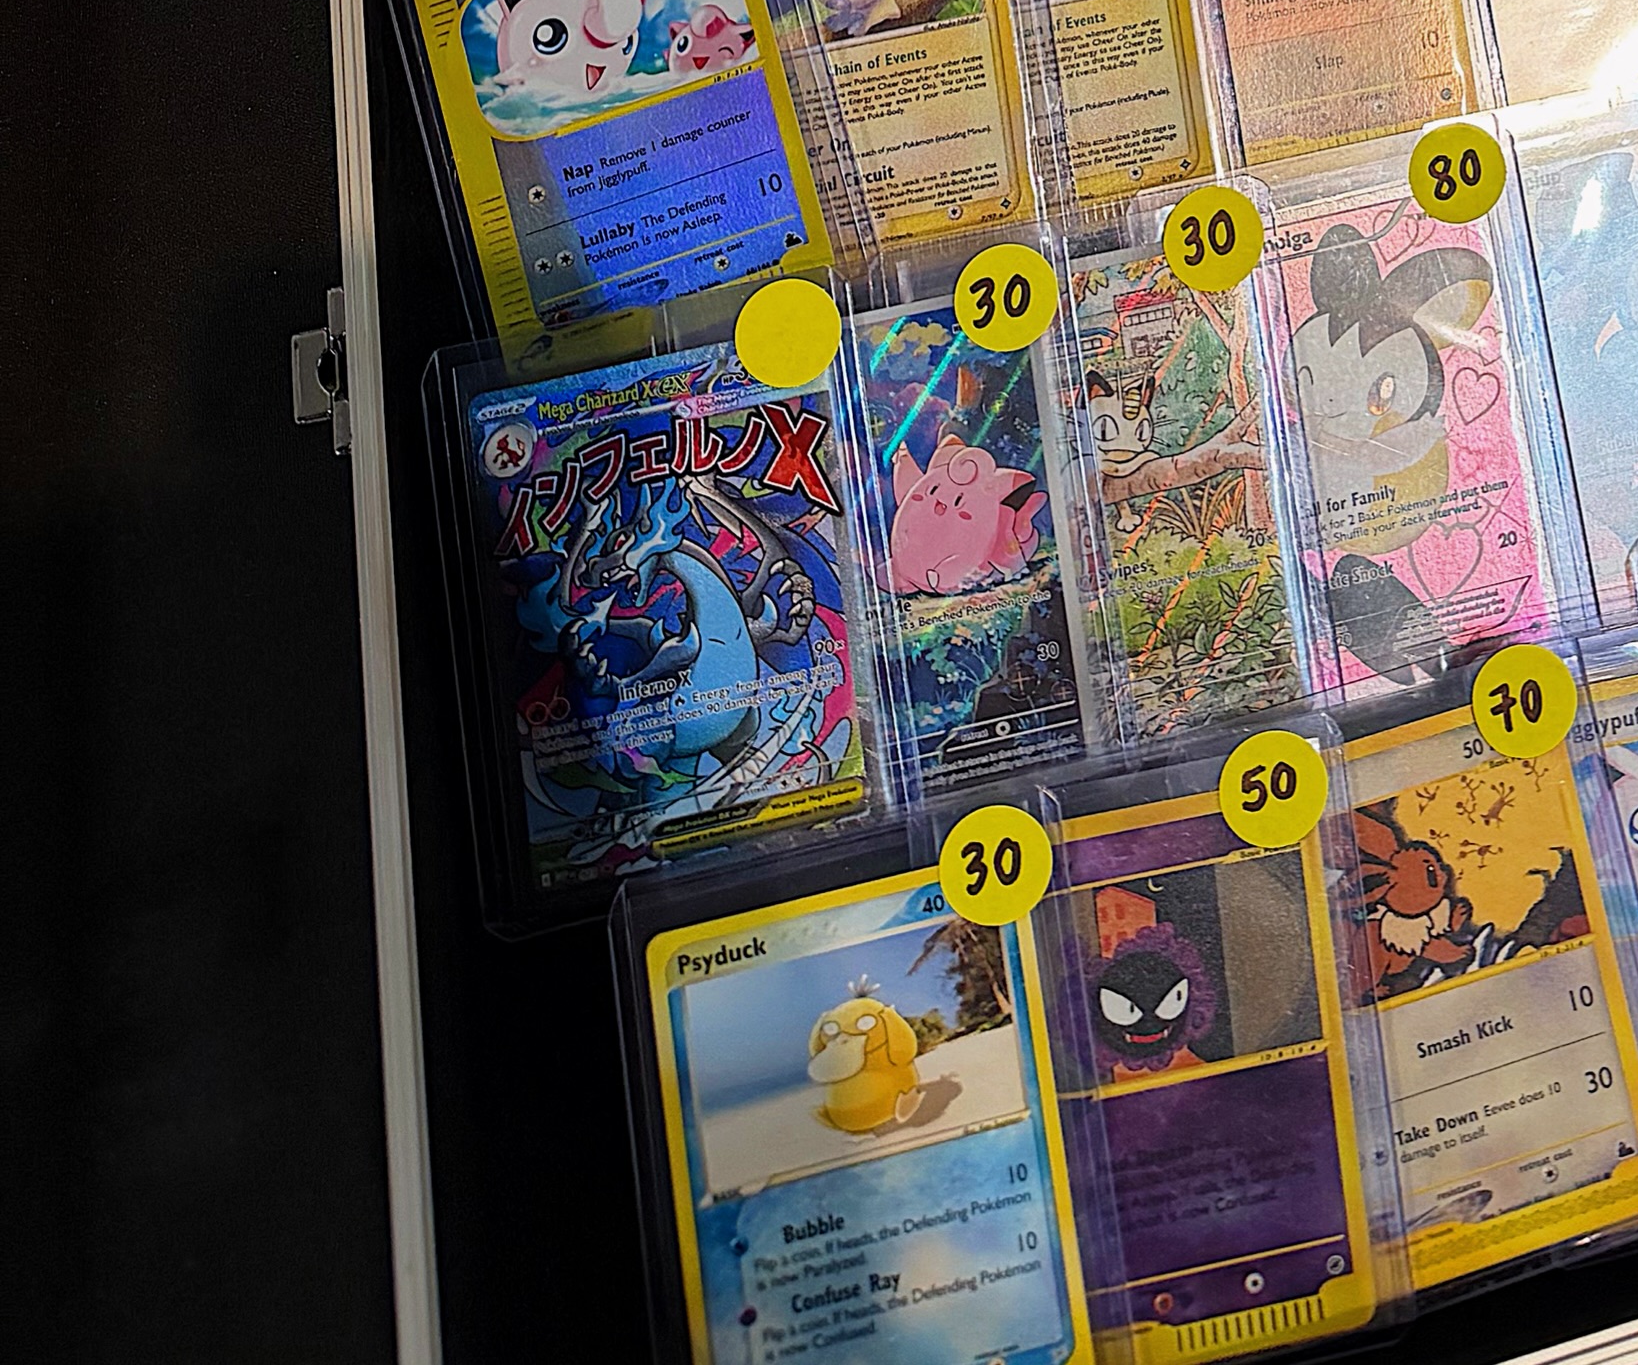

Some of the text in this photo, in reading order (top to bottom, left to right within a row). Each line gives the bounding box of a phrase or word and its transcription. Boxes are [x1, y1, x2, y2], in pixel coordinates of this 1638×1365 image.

[563, 149, 647, 182] Nap Remove
[1428, 150, 1481, 200] 80
[757, 173, 783, 197] 10
[579, 191, 727, 250] Lullaby The Defending
[1181, 209, 1235, 266] 30
[969, 276, 1030, 327] 30
[1324, 484, 1396, 513] for Family
[1489, 681, 1543, 732] 70
[1241, 762, 1297, 812] 50
[961, 837, 1021, 896] 30
[677, 938, 767, 975] Psyduck
[1568, 985, 1593, 1011] 10
[1417, 1014, 1514, 1059] Smash Kick
[1585, 1066, 1613, 1093] 30
[1395, 1107, 1479, 1145] Take Down
[1008, 1164, 1028, 1183] 10
[784, 1212, 845, 1244] Bubble
[1017, 1232, 1037, 1251] 10
[792, 1273, 901, 1314] Confuse Ray
